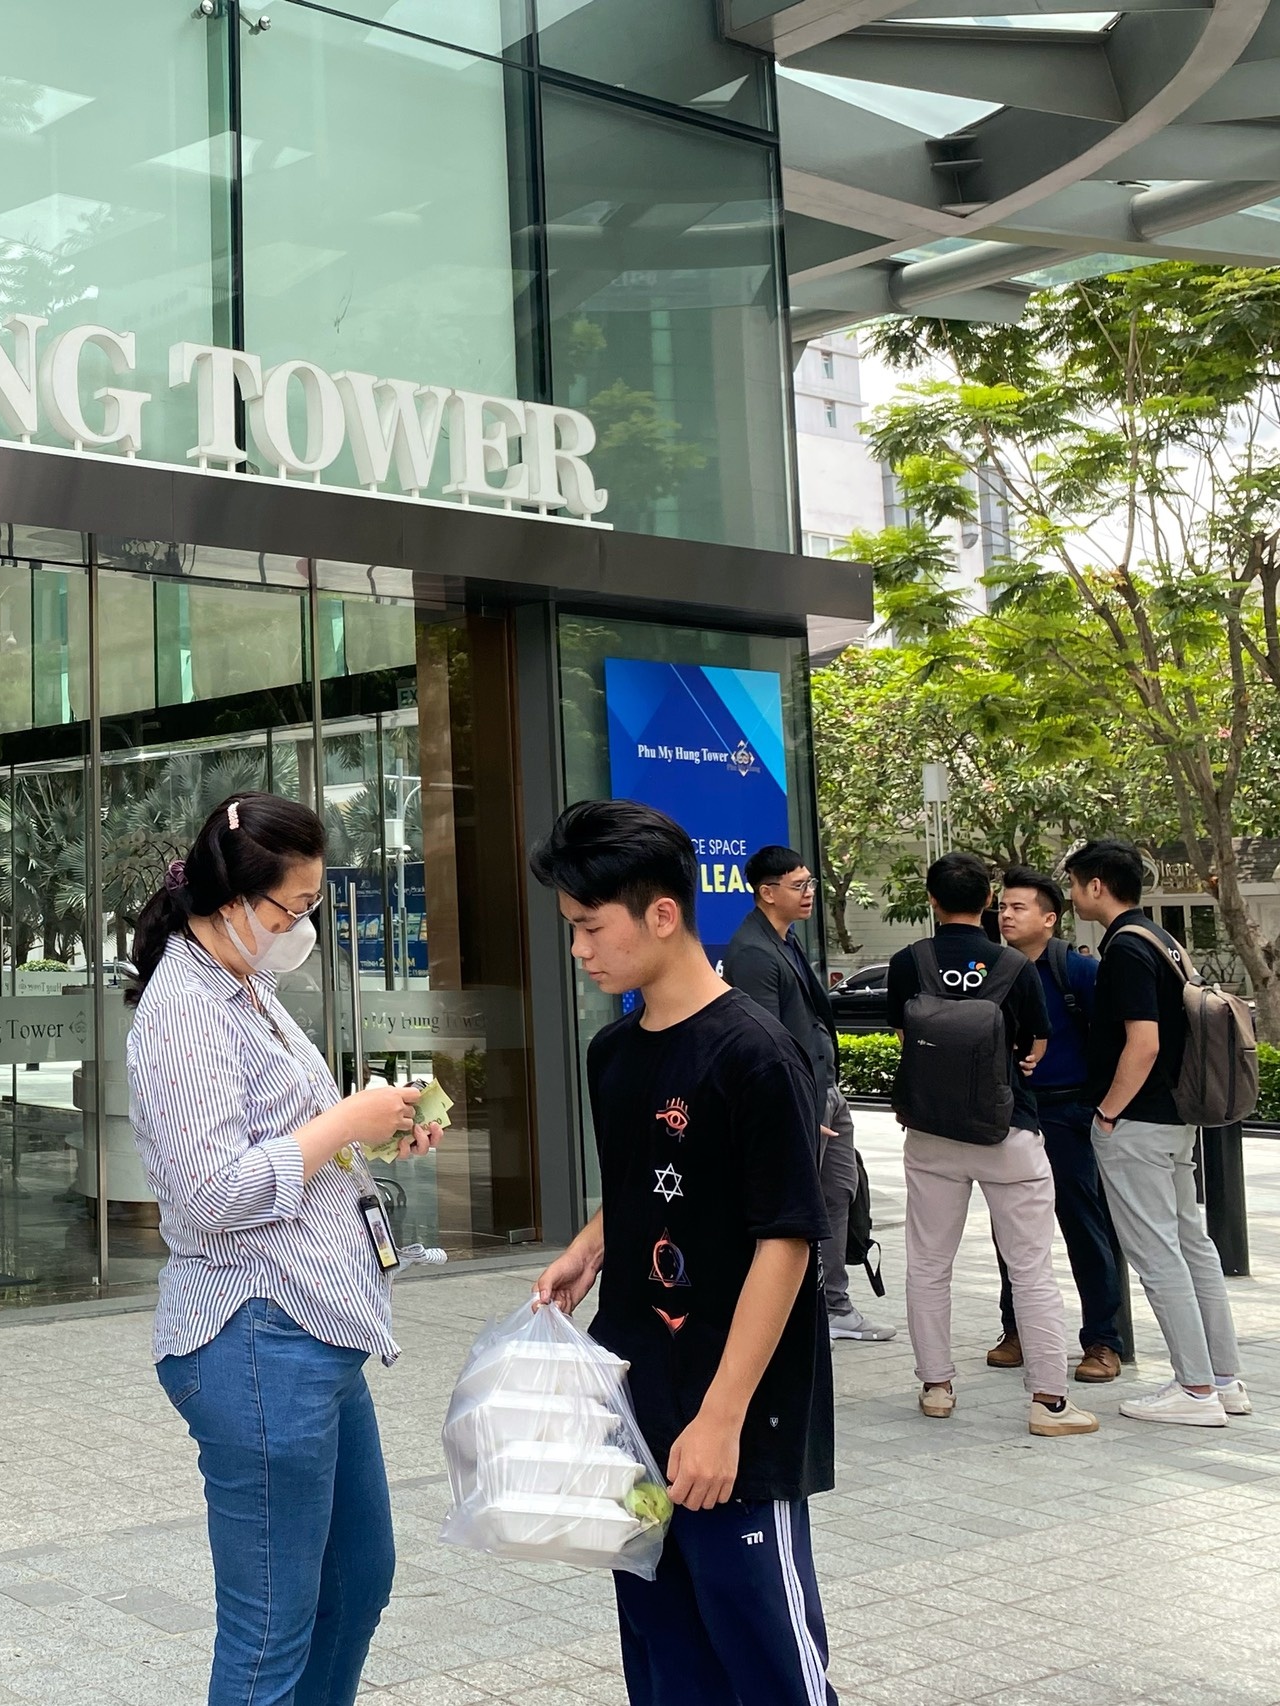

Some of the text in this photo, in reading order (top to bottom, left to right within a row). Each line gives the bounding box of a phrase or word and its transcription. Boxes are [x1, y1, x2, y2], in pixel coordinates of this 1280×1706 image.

[169, 341, 609, 515] TOWER
[637, 744, 729, 764] Phu My Hung Tower
[709, 839, 747, 856] SPACE
[939, 969, 983, 991] op
[6, 1019, 64, 1041] Tower
